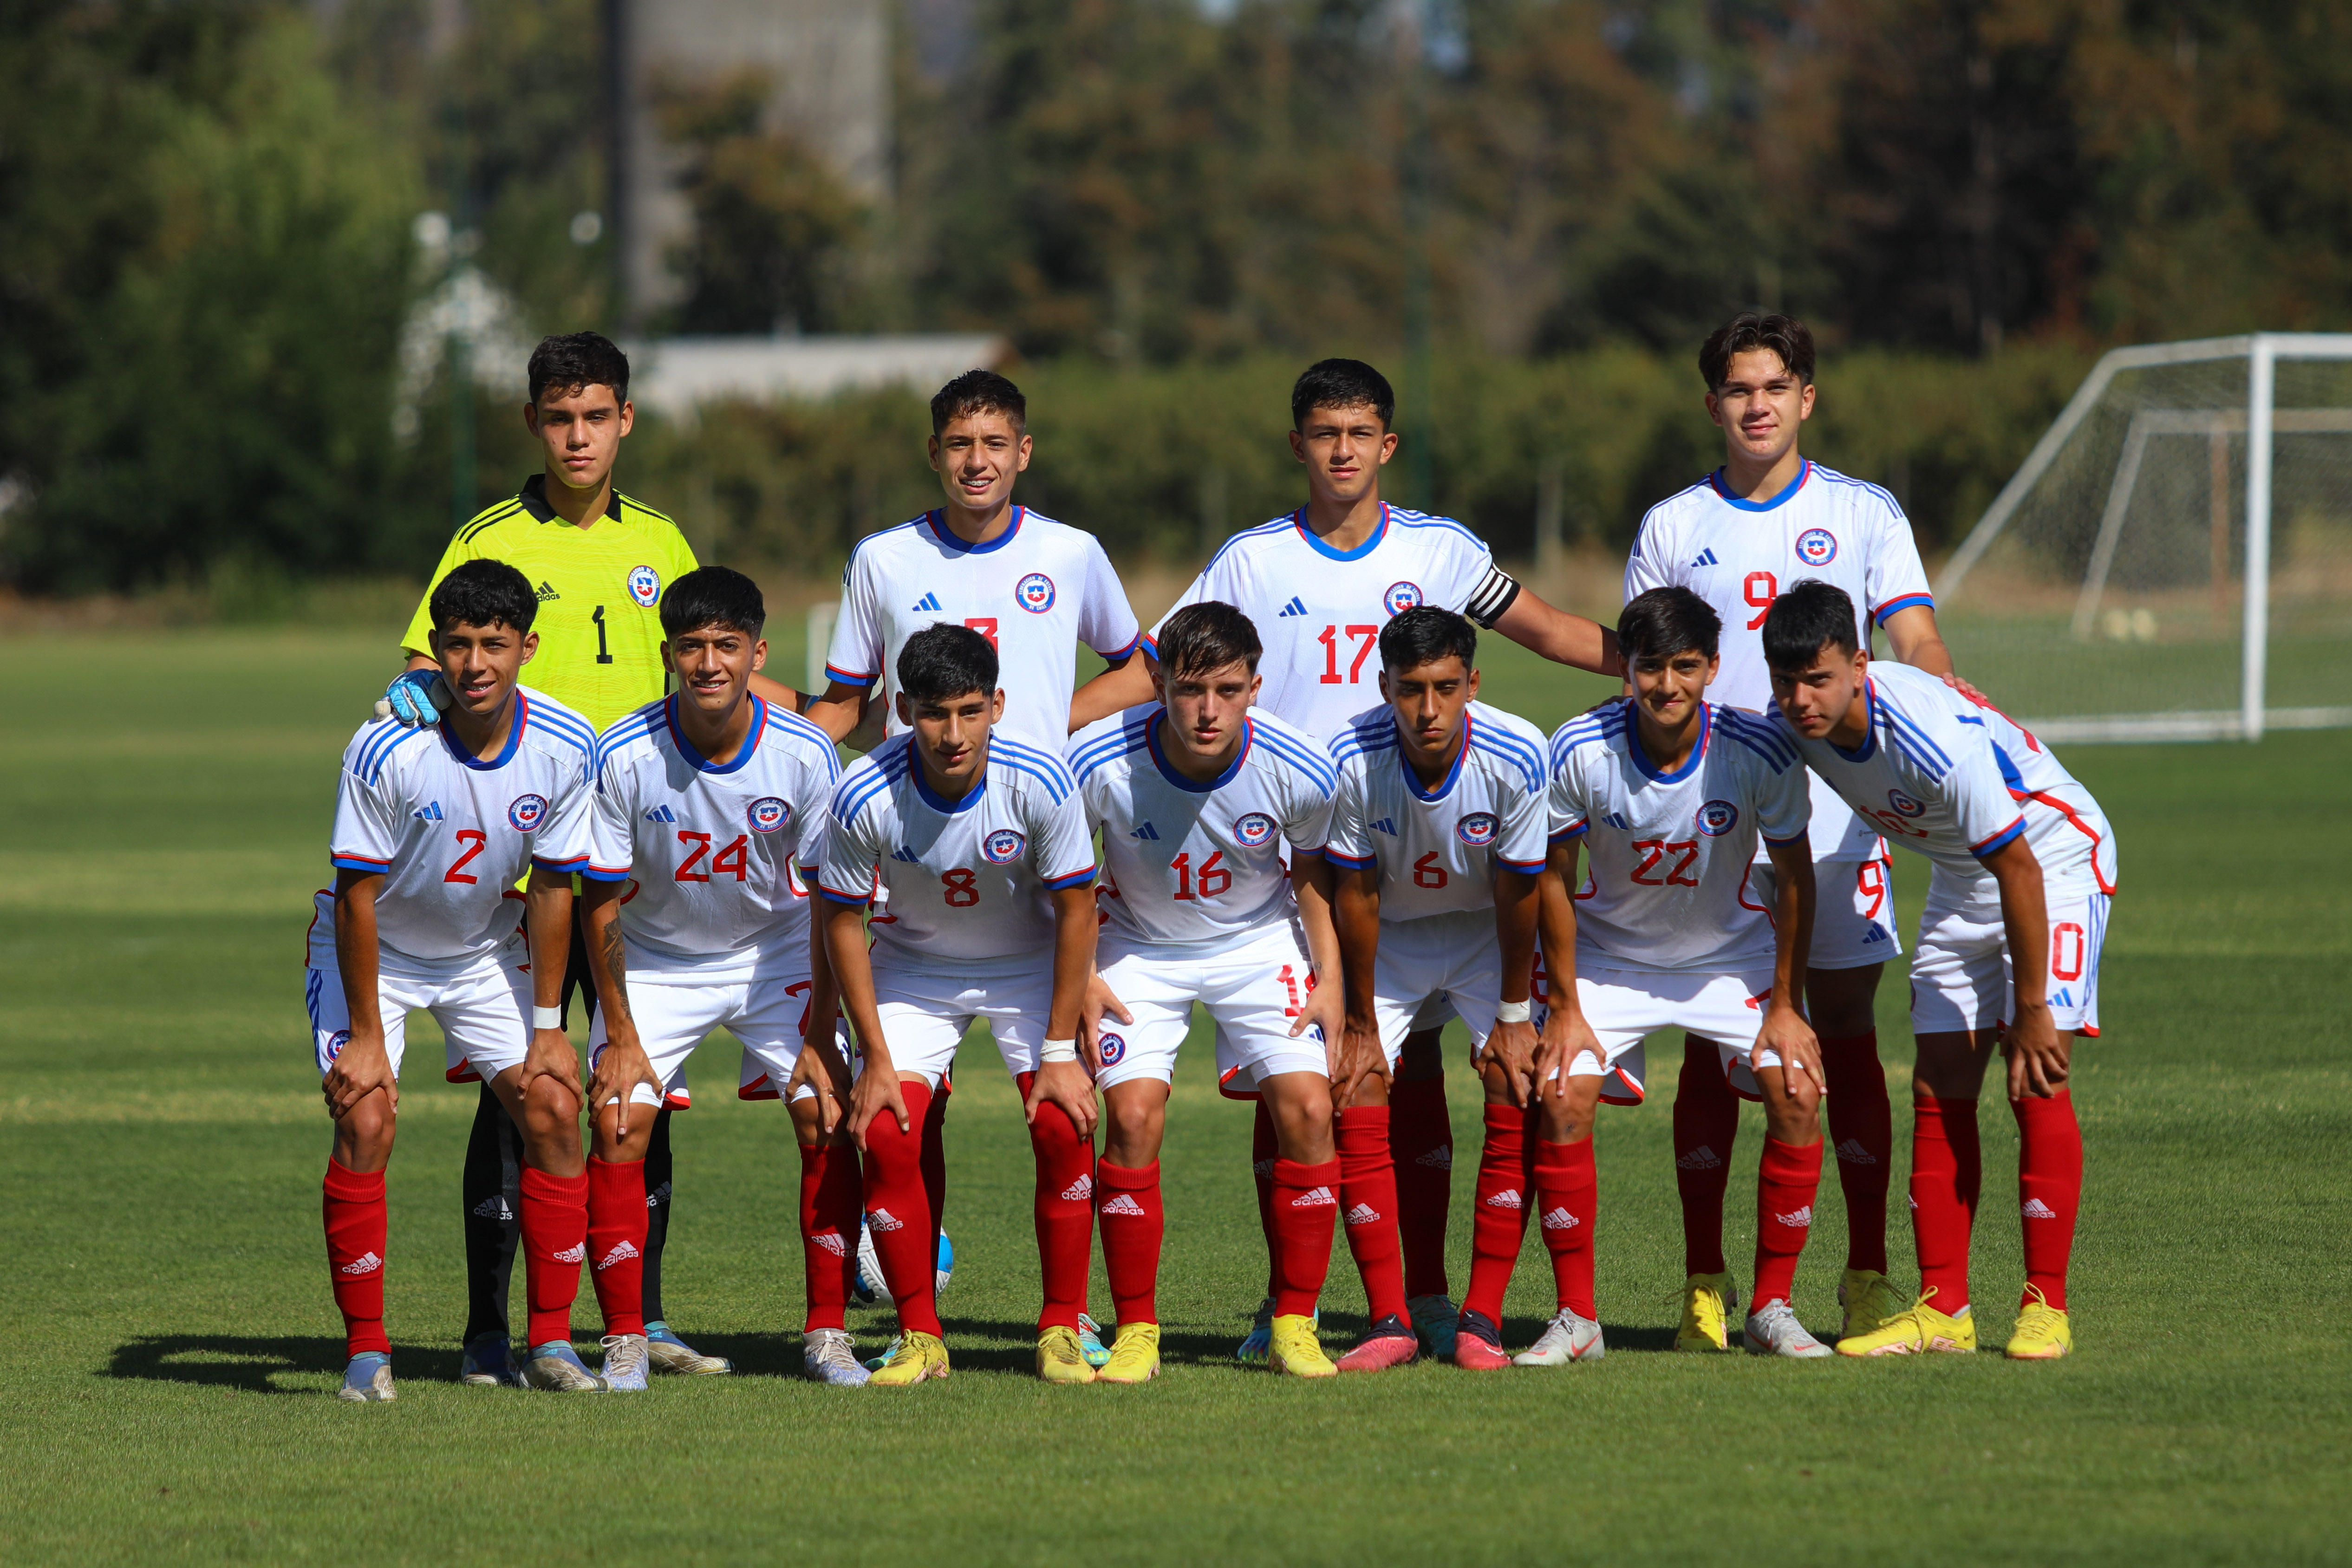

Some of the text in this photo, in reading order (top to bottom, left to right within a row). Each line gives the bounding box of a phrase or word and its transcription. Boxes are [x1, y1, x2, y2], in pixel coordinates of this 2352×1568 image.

[1799, 532, 1816, 548] FEDERACION
[628, 566, 645, 585] FEDERACION
[1019, 576, 1035, 595] FEDERACION
[1388, 585, 1404, 601] FEDERACION
[537, 593, 560, 602] didas
[1744, 572, 1777, 630] 9
[592, 605, 612, 664] 1
[1317, 625, 1378, 683] 17
[511, 796, 531, 812] FEDERACION
[751, 800, 769, 815] FEDERACION
[987, 833, 1003, 849] FEDERACION
[443, 829, 487, 885] 2
[675, 830, 747, 882] 24
[1631, 840, 1699, 886] 22
[1171, 851, 1232, 900] 16
[1414, 851, 1447, 889] 6
[941, 868, 979, 907] 8
[1858, 860, 1884, 919] 9
[1677, 1157, 1720, 1170] adidas
[1102, 1206, 1144, 1215] adidas
[1292, 1197, 1336, 1206] adidas
[1487, 1198, 1525, 1208] adidas
[474, 1207, 512, 1220] adidas
[1345, 1213, 1380, 1224] adidas
[554, 1249, 585, 1262] adida
[811, 1236, 855, 1257] adidas
[342, 1258, 382, 1275] adidas
[598, 1250, 638, 1269] adidas
